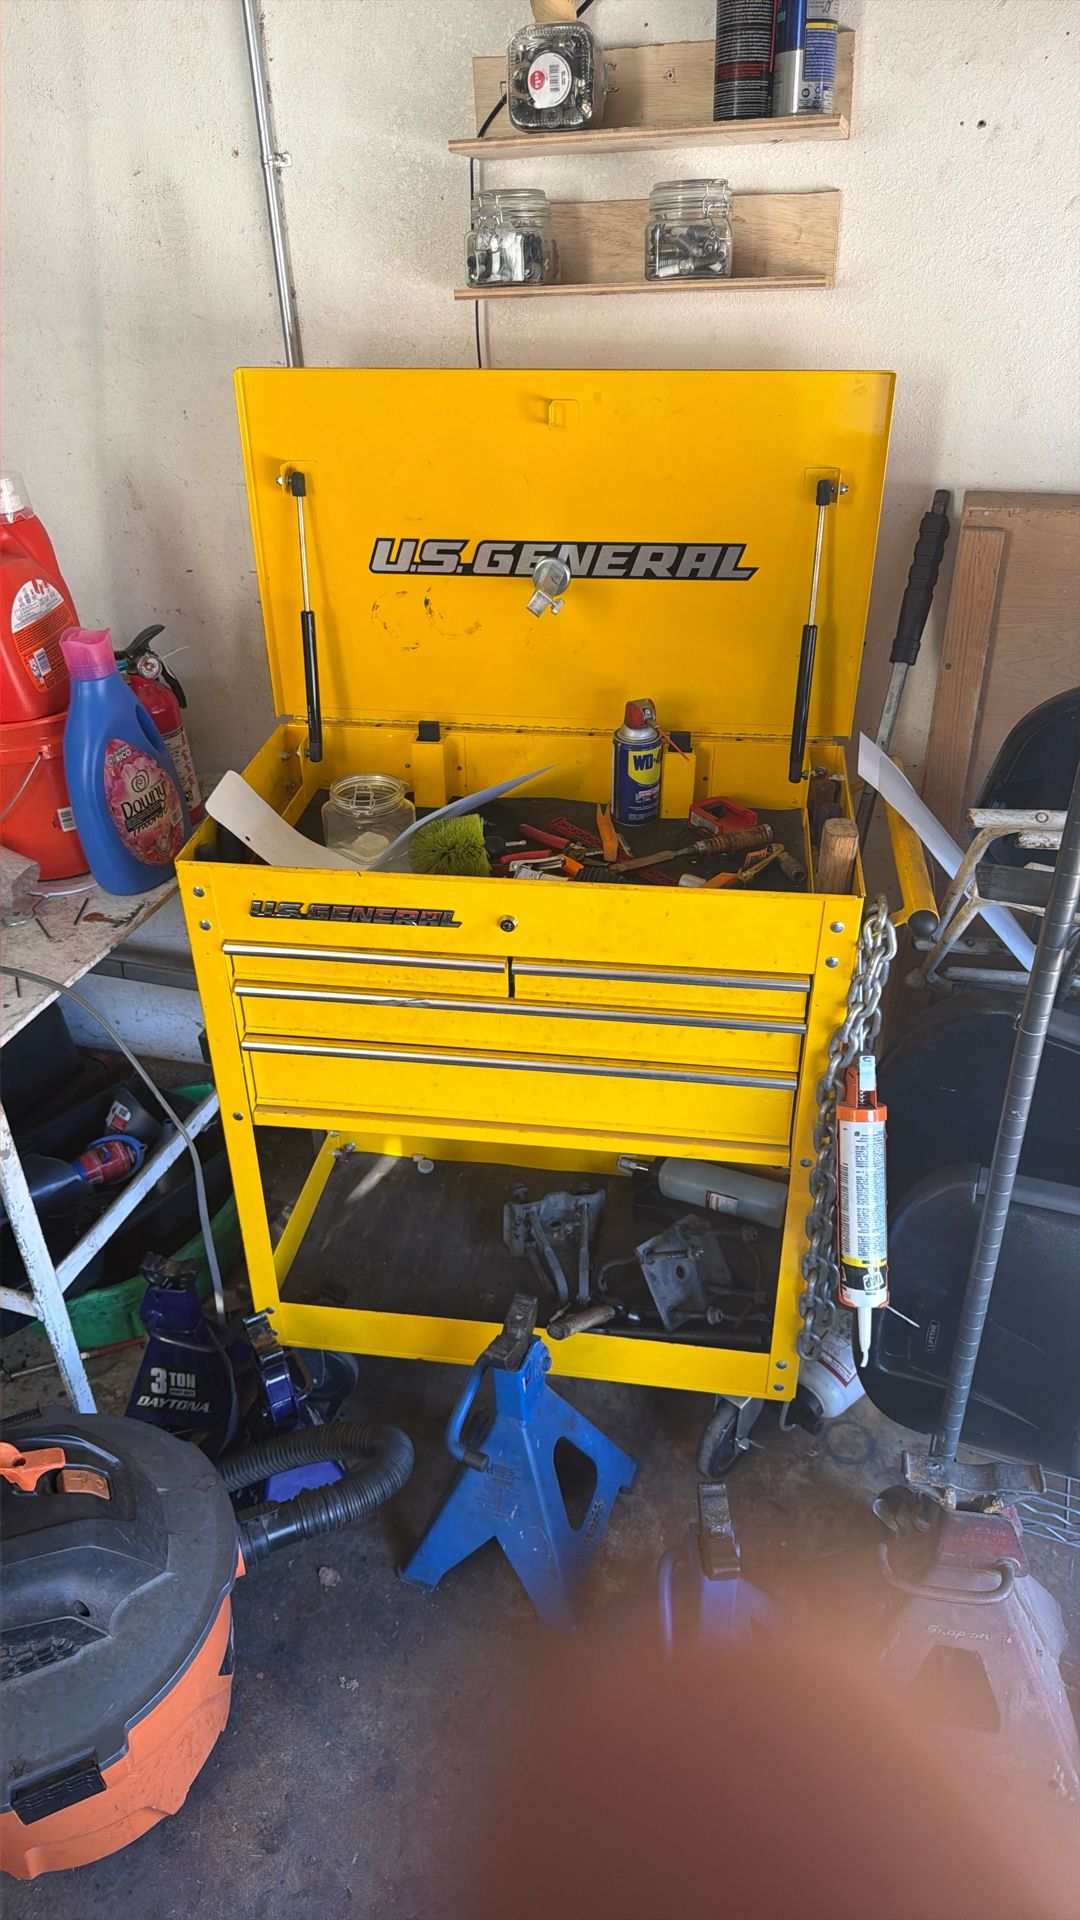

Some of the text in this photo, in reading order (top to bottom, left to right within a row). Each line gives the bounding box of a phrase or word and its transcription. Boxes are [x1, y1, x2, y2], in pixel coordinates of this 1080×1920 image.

[472, 541, 758, 580] GENERAL
[150, 1367, 168, 1394] 3
[168, 1372, 196, 1388] TON
[136, 1395, 210, 1412] DAYTONA
